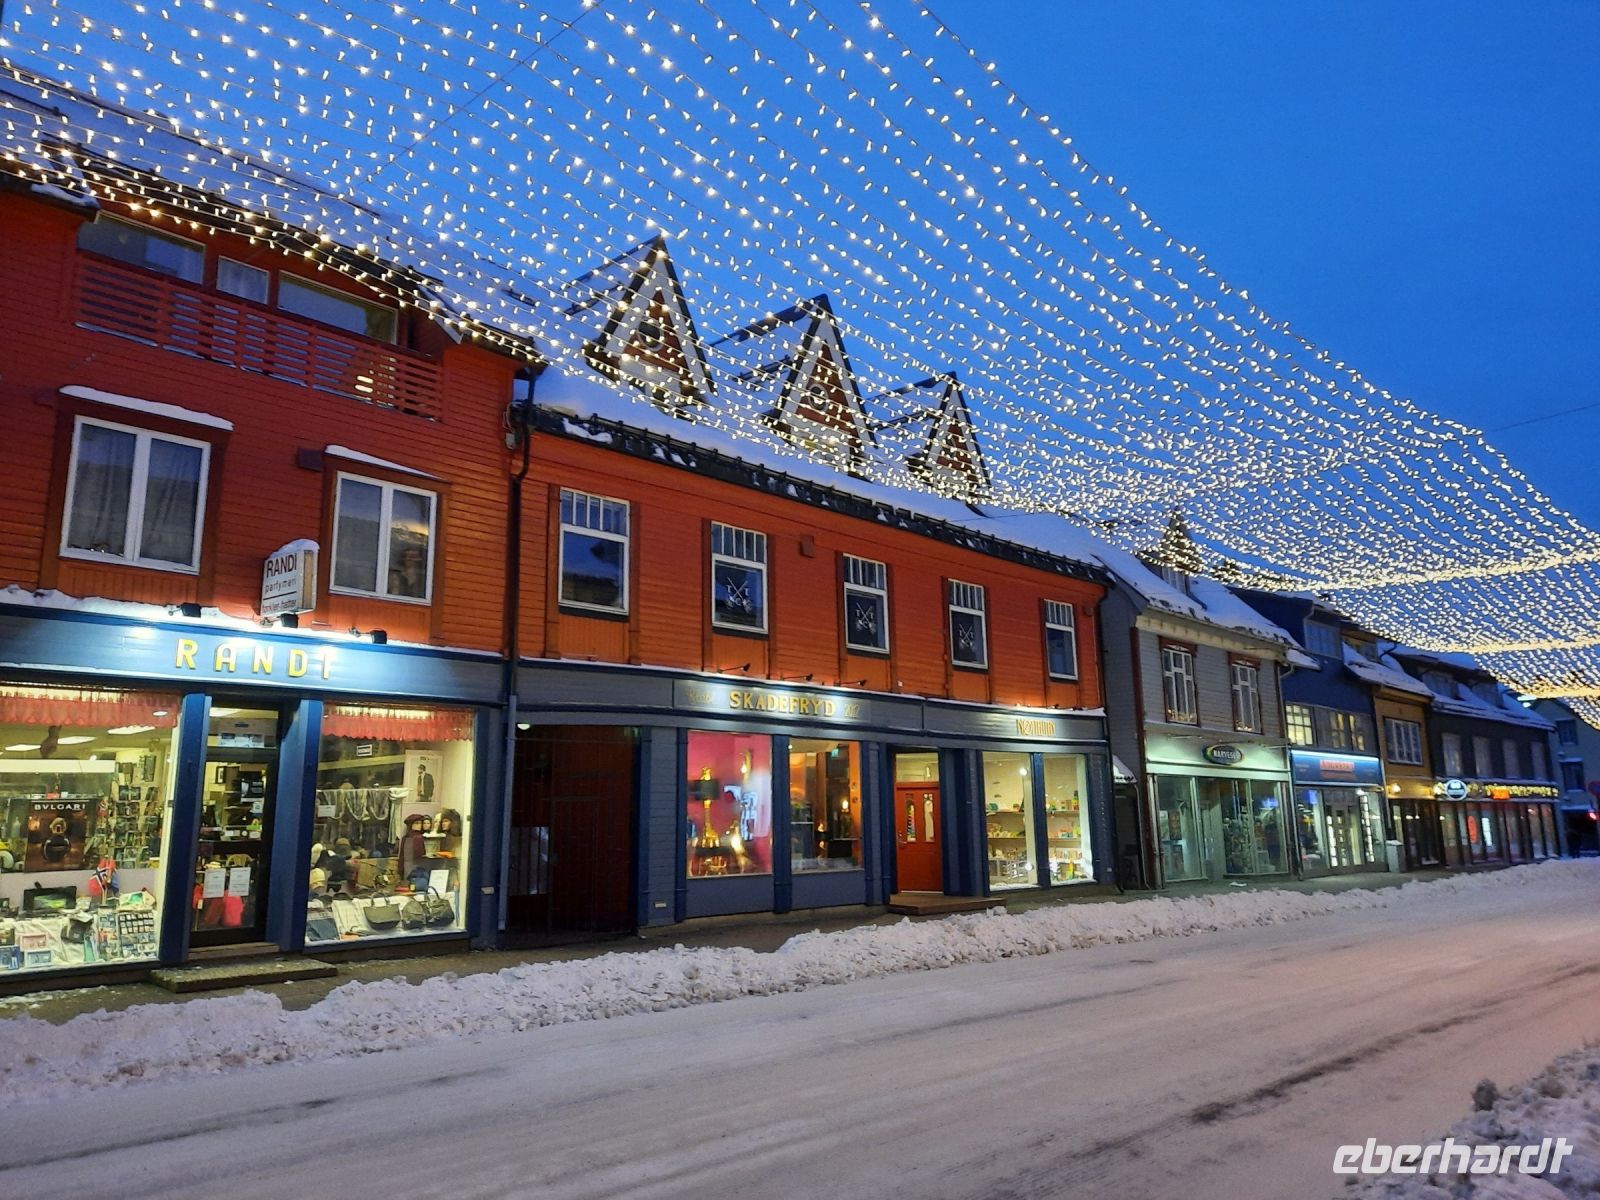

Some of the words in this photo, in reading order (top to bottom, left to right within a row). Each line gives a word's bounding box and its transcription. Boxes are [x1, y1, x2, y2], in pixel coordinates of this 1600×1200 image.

[266, 553, 297, 578] RANDI
[175, 638, 333, 680] RANDI
[730, 690, 836, 717] SKADEFRYD
[34, 803, 86, 811] BVLGARI
